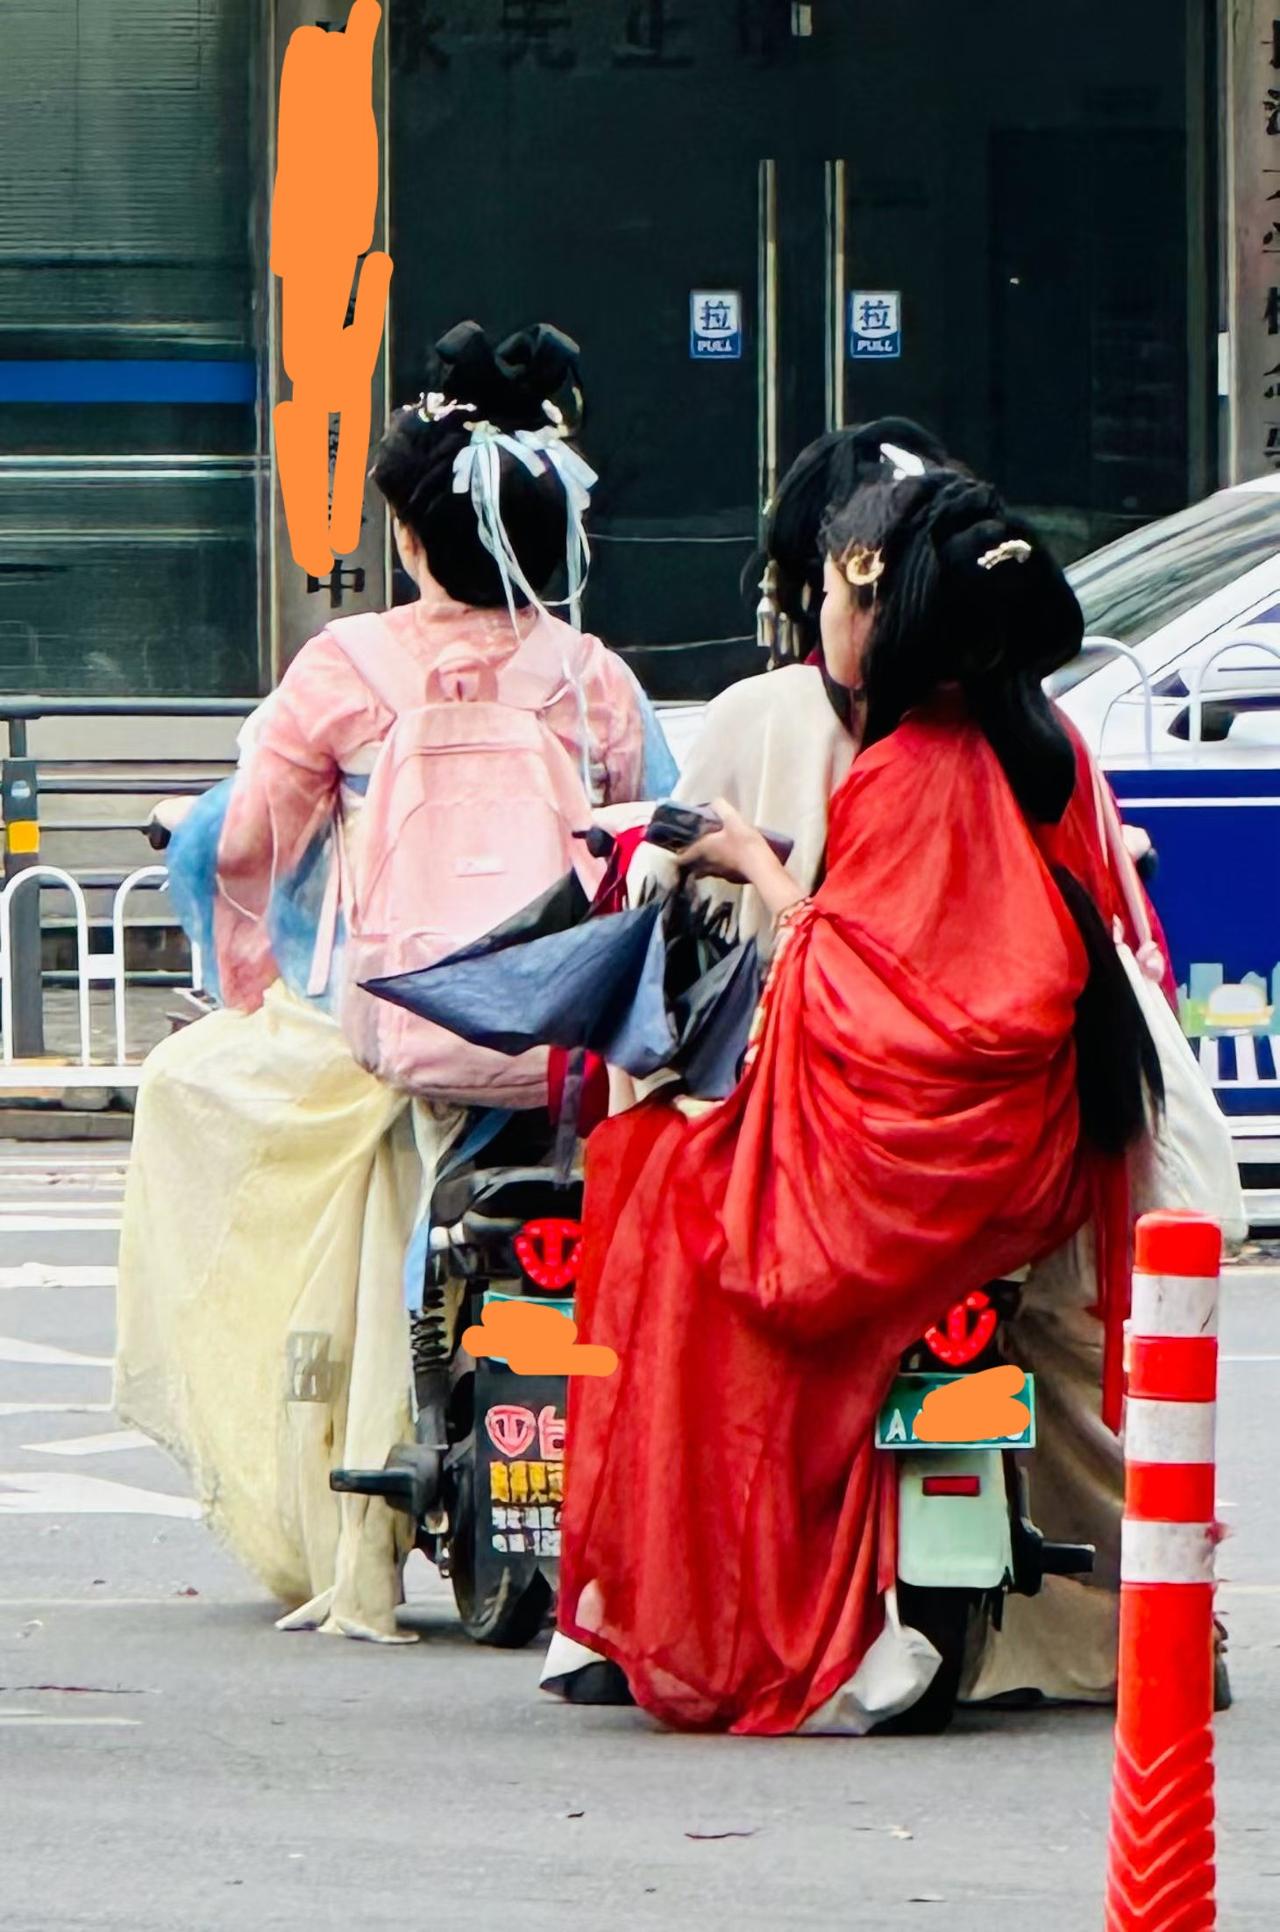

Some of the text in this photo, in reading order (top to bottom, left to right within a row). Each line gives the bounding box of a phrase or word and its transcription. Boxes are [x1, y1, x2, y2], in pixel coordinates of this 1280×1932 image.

[700, 300, 731, 331] 拉
[860, 300, 891, 331] 拉
[697, 340, 732, 352] PULL
[857, 340, 893, 352] PULL
